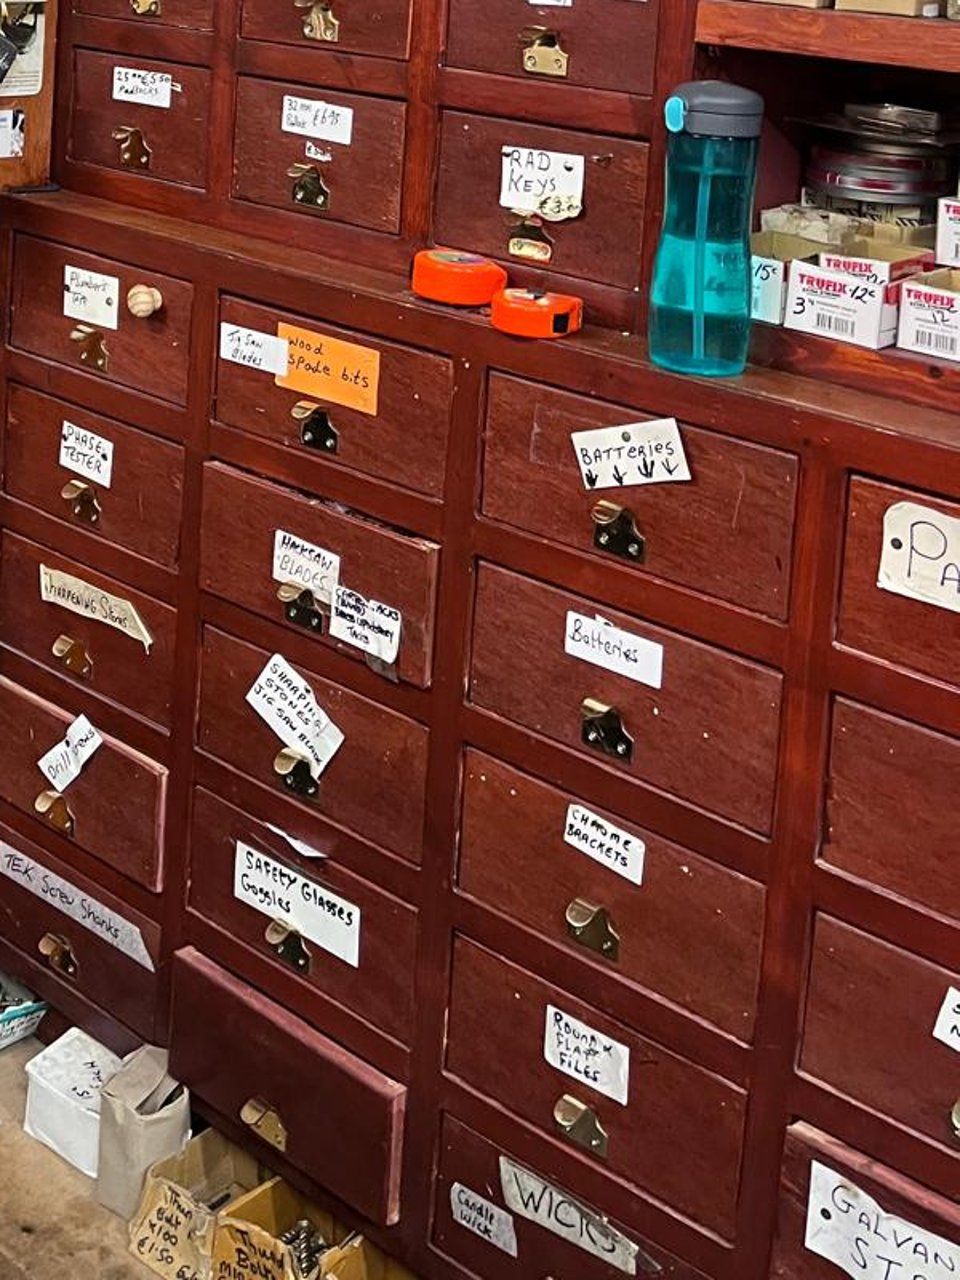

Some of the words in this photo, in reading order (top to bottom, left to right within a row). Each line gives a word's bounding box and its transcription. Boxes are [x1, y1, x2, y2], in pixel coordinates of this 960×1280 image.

[509, 150, 552, 171] RAD
[825, 258, 873, 273] TRUFIX
[798, 273, 848, 294] TRUFIX
[905, 289, 957, 306] TRUFIX
[66, 425, 101, 454] PHASE
[63, 446, 102, 474] TESTER
[568, 618, 638, 664] Batteries
[265, 678, 311, 725] STONES
[567, 823, 628, 868] BRACKETS
